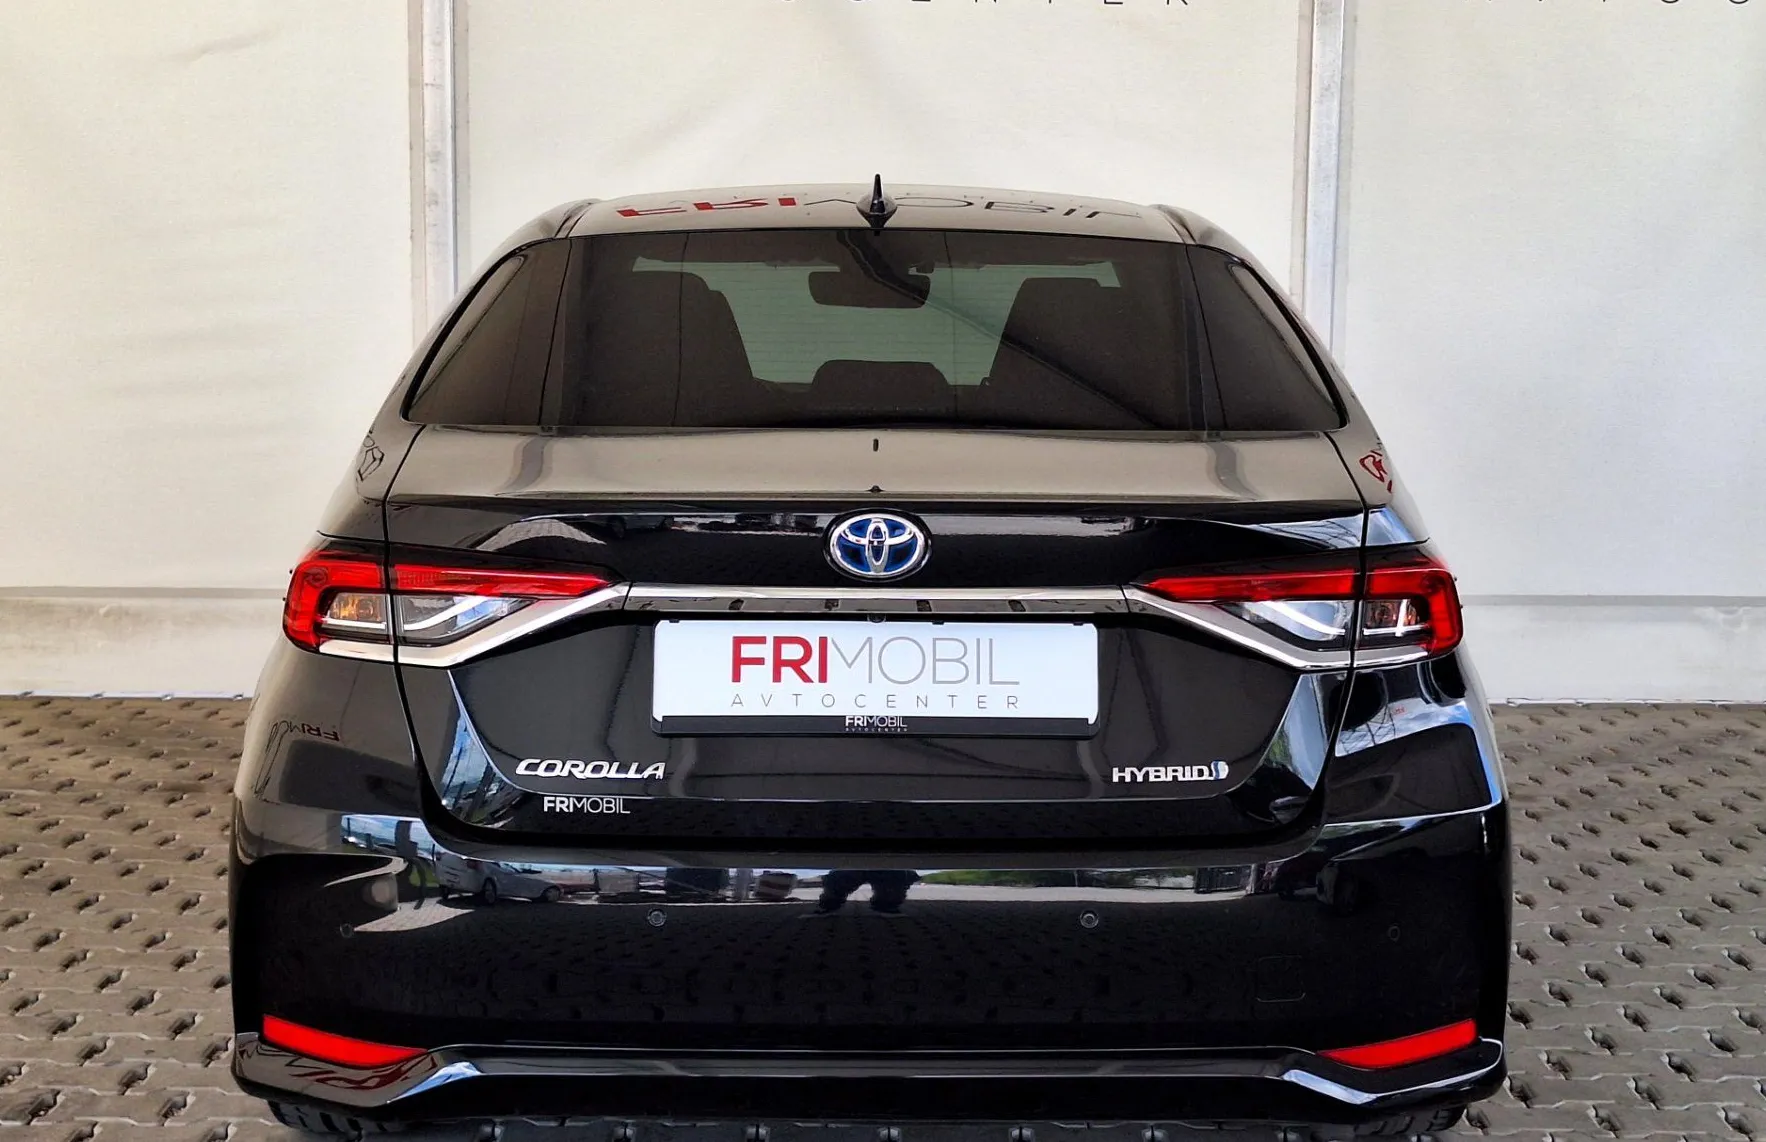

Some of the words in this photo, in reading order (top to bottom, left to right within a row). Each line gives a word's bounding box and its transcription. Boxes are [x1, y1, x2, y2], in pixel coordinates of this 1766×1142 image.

[731, 636, 1019, 685] FRIMOBIL
[731, 694, 1018, 709] AVTOCENTER
[845, 715, 907, 727] FRIMOBIL
[516, 759, 665, 779] COROLLA
[1112, 765, 1210, 782] HYBRID
[544, 797, 630, 813] FRIMOBIL
